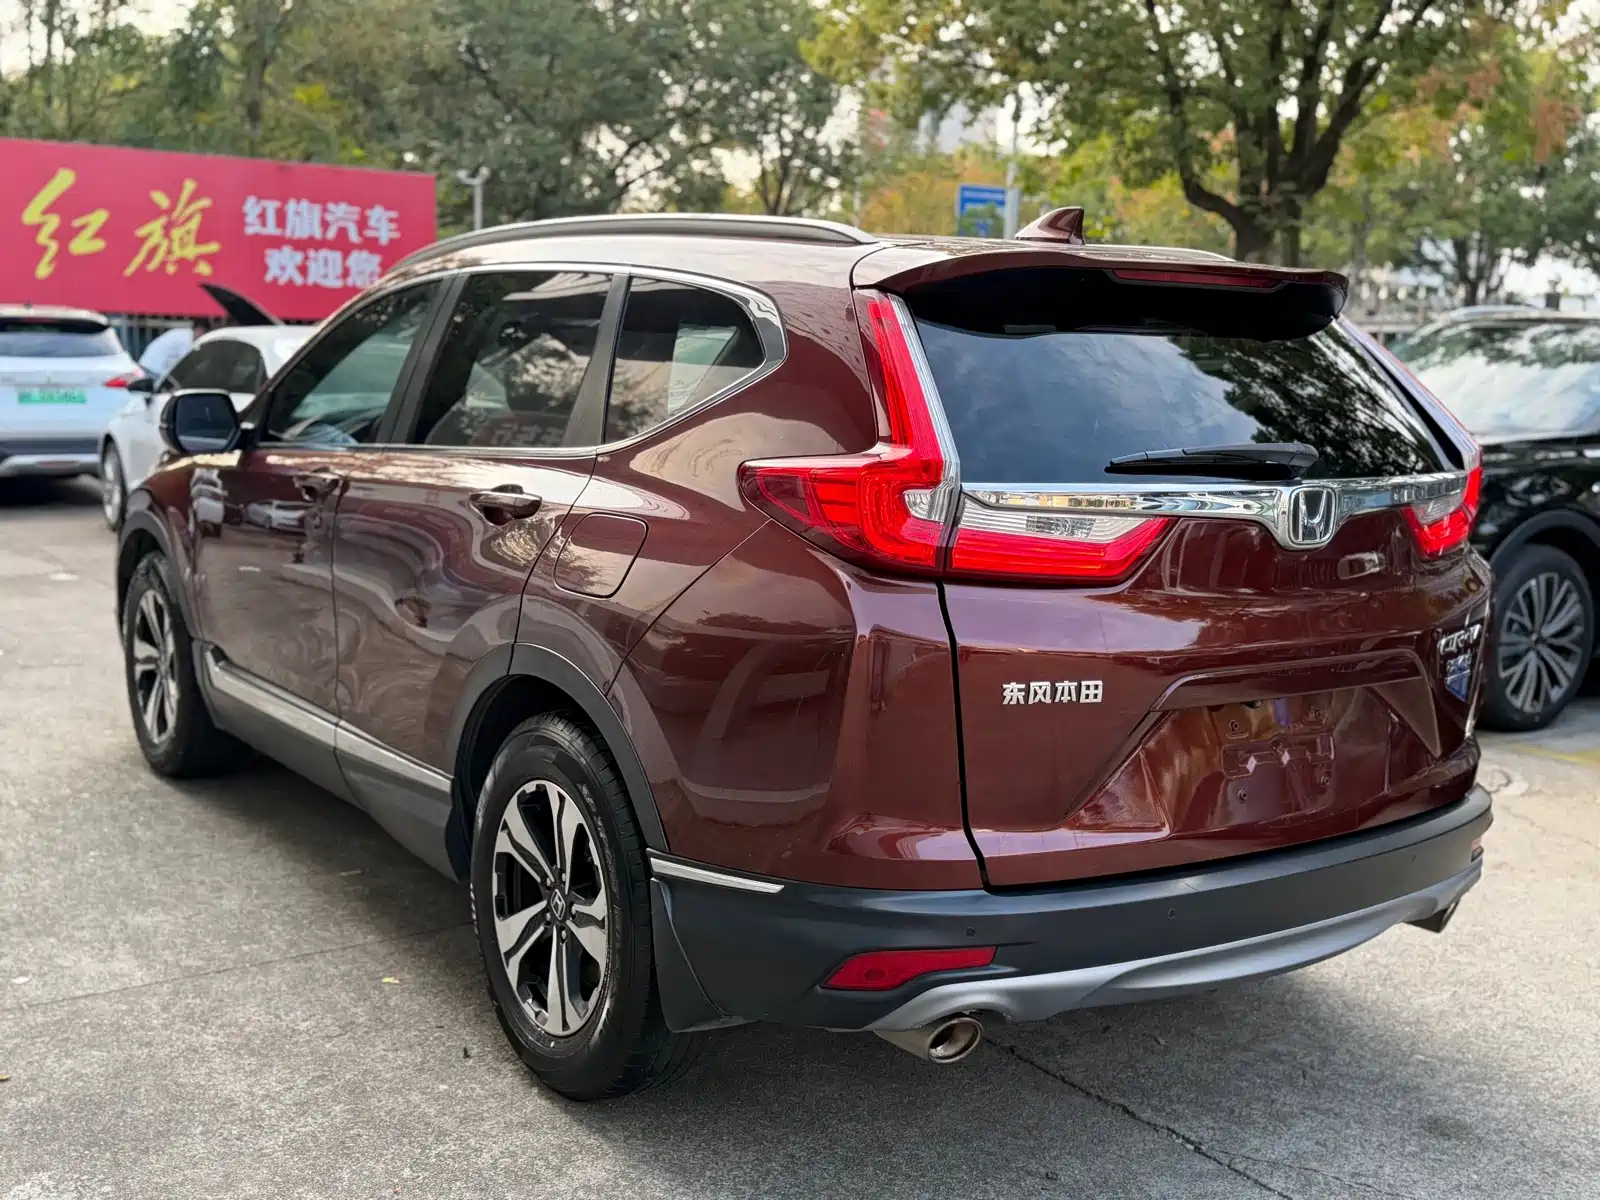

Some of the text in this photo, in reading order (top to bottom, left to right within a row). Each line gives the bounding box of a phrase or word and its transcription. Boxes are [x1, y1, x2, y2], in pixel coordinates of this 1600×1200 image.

[22, 168, 221, 279] 红旗
[243, 195, 401, 246] 红旗汽车
[264, 245, 383, 289] 欢迎您
[1002, 680, 1103, 705] 东风本田
